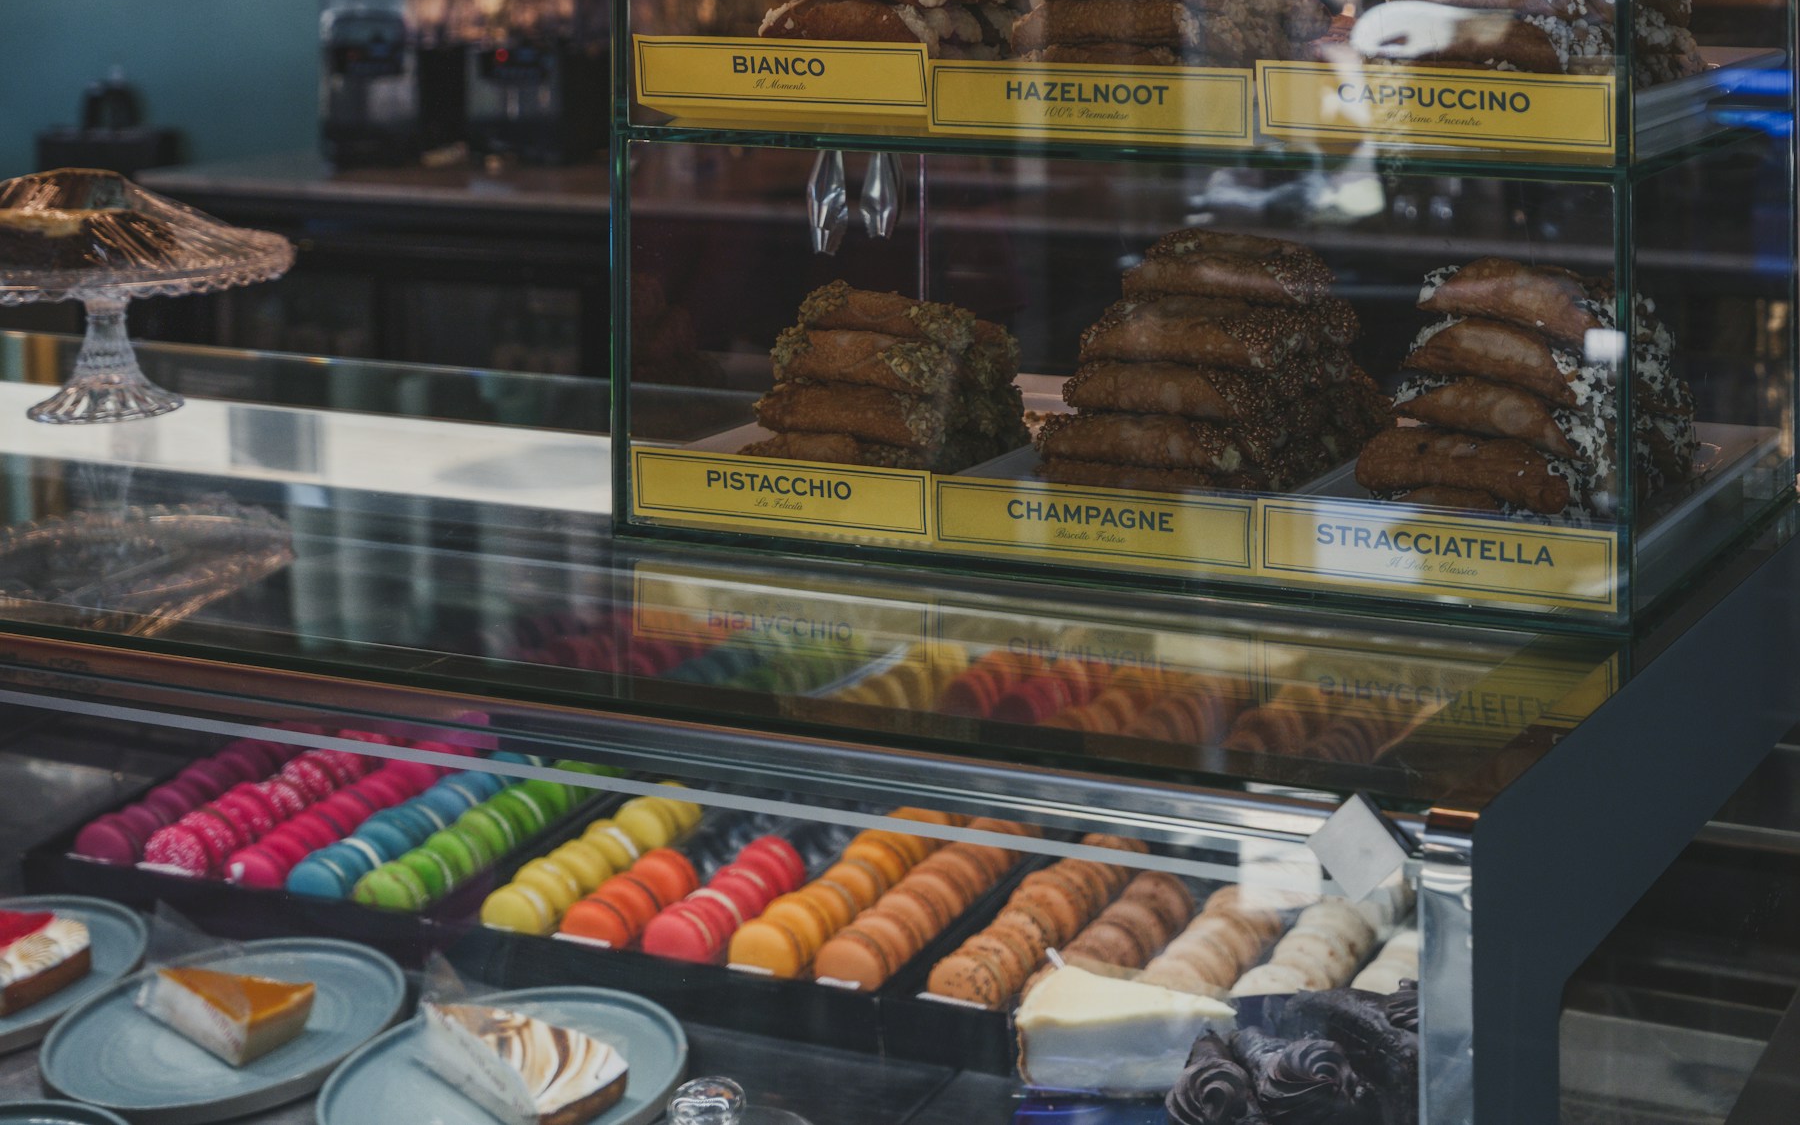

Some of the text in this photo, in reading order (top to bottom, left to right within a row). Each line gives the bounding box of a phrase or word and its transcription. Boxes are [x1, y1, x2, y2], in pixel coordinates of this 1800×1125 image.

[732, 55, 825, 77] BIANCO
[752, 78, 807, 91] Il Momento
[1006, 80, 1169, 106] HAZELNOOT
[1337, 82, 1531, 114] CAPPUCCINO
[1043, 106, 1130, 121] 100% Piemontese
[1400, 110, 1432, 123] Primo
[1434, 113, 1482, 126] Incontro
[706, 469, 852, 501] PISTACCHIO
[754, 497, 769, 507] La
[1006, 499, 1175, 533] CHAMPAGNE
[1055, 527, 1090, 541] Biscotto
[1316, 523, 1554, 568] STRACCIATELLA
[1403, 558, 1434, 572] Dolce
[1438, 560, 1479, 576] Classico
